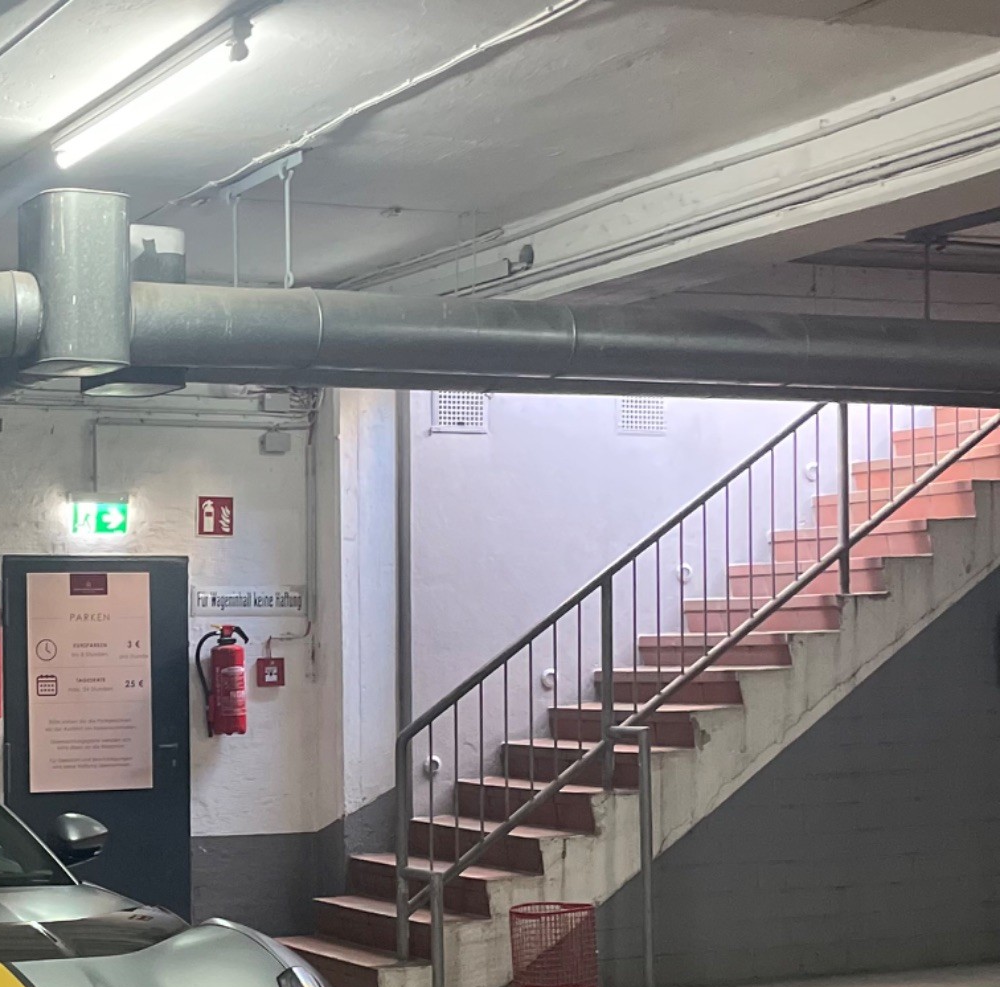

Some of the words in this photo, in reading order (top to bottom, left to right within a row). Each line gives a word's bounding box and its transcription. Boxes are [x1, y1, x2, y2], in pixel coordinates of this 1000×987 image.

[253, 591, 273, 607] keine
[275, 591, 303, 610] Haftung
[69, 613, 111, 622] PARKEN
[127, 640, 132, 649] 3
[125, 680, 135, 688] 25
[138, 680, 144, 688] €
